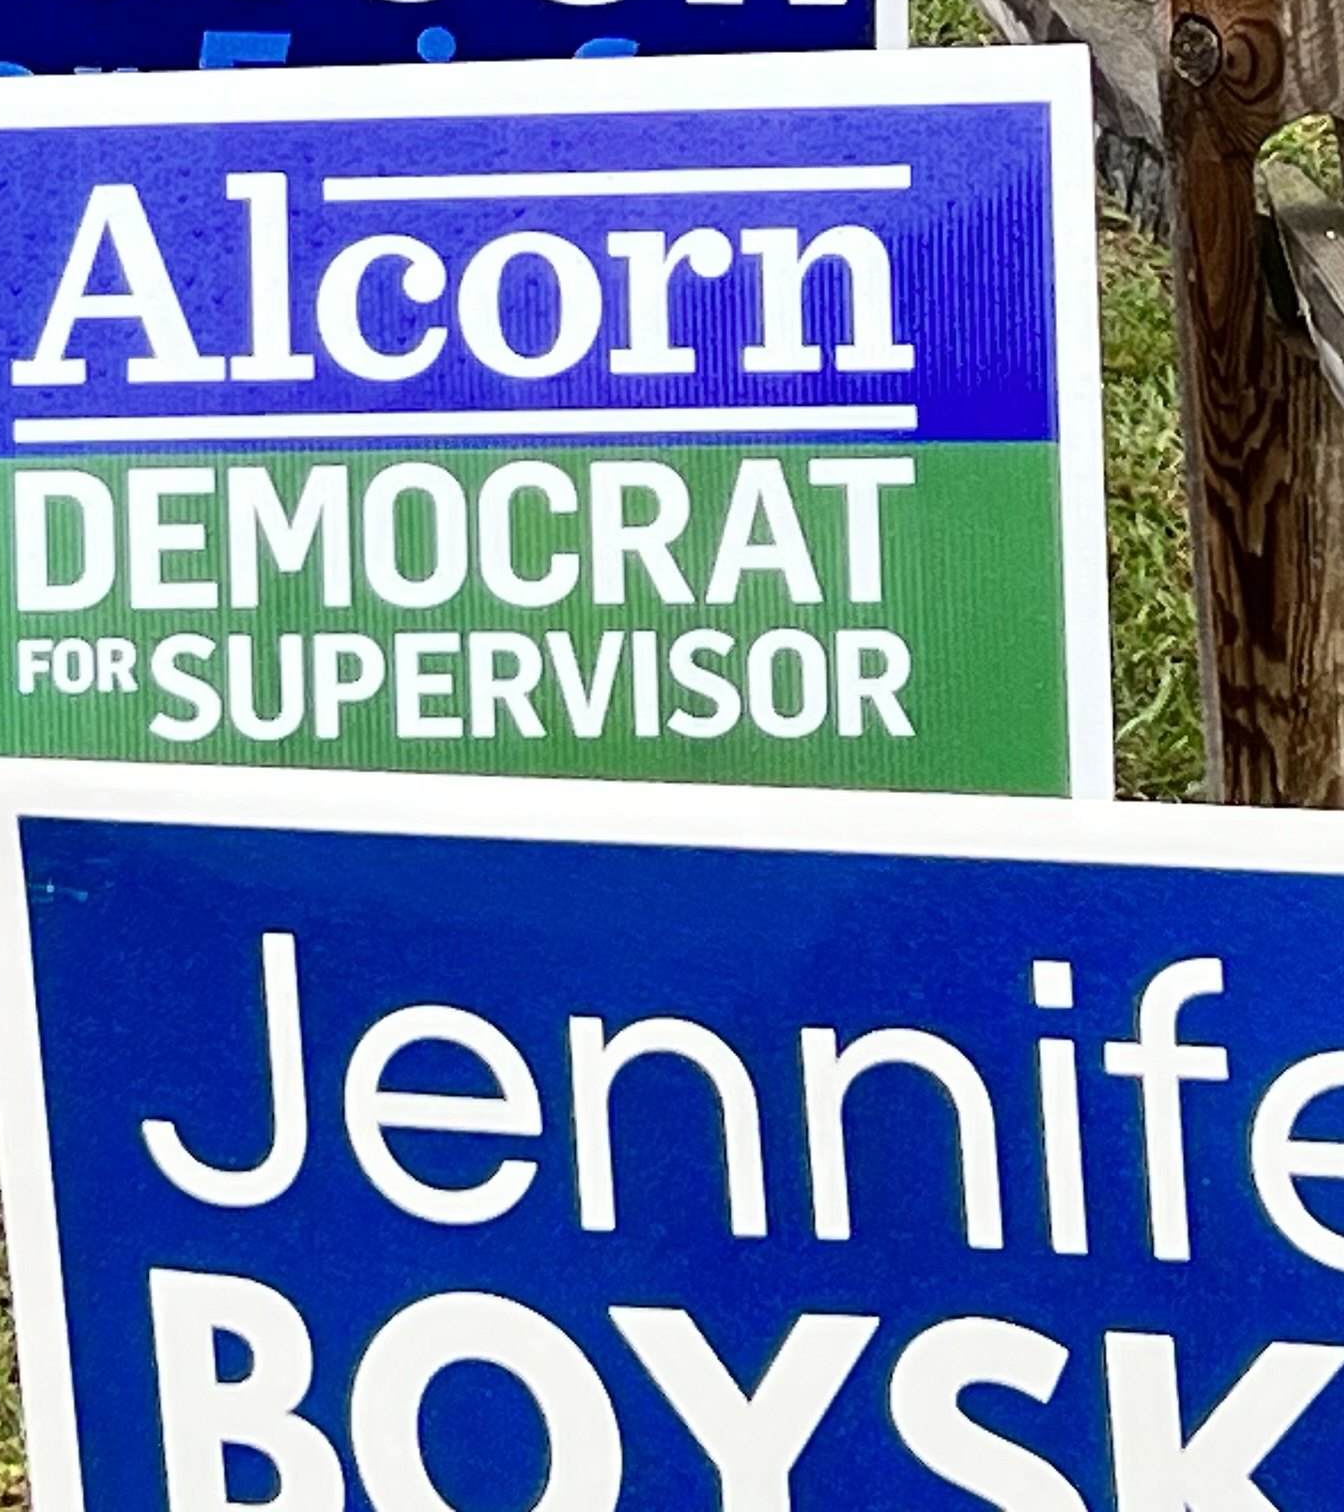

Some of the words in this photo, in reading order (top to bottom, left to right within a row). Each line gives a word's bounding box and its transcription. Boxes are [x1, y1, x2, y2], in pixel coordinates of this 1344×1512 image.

[10, 173, 915, 386] Alcorn
[12, 455, 917, 614] DEMOCRAT
[17, 637, 138, 696] FOR
[148, 628, 917, 744] SUPERVISOR
